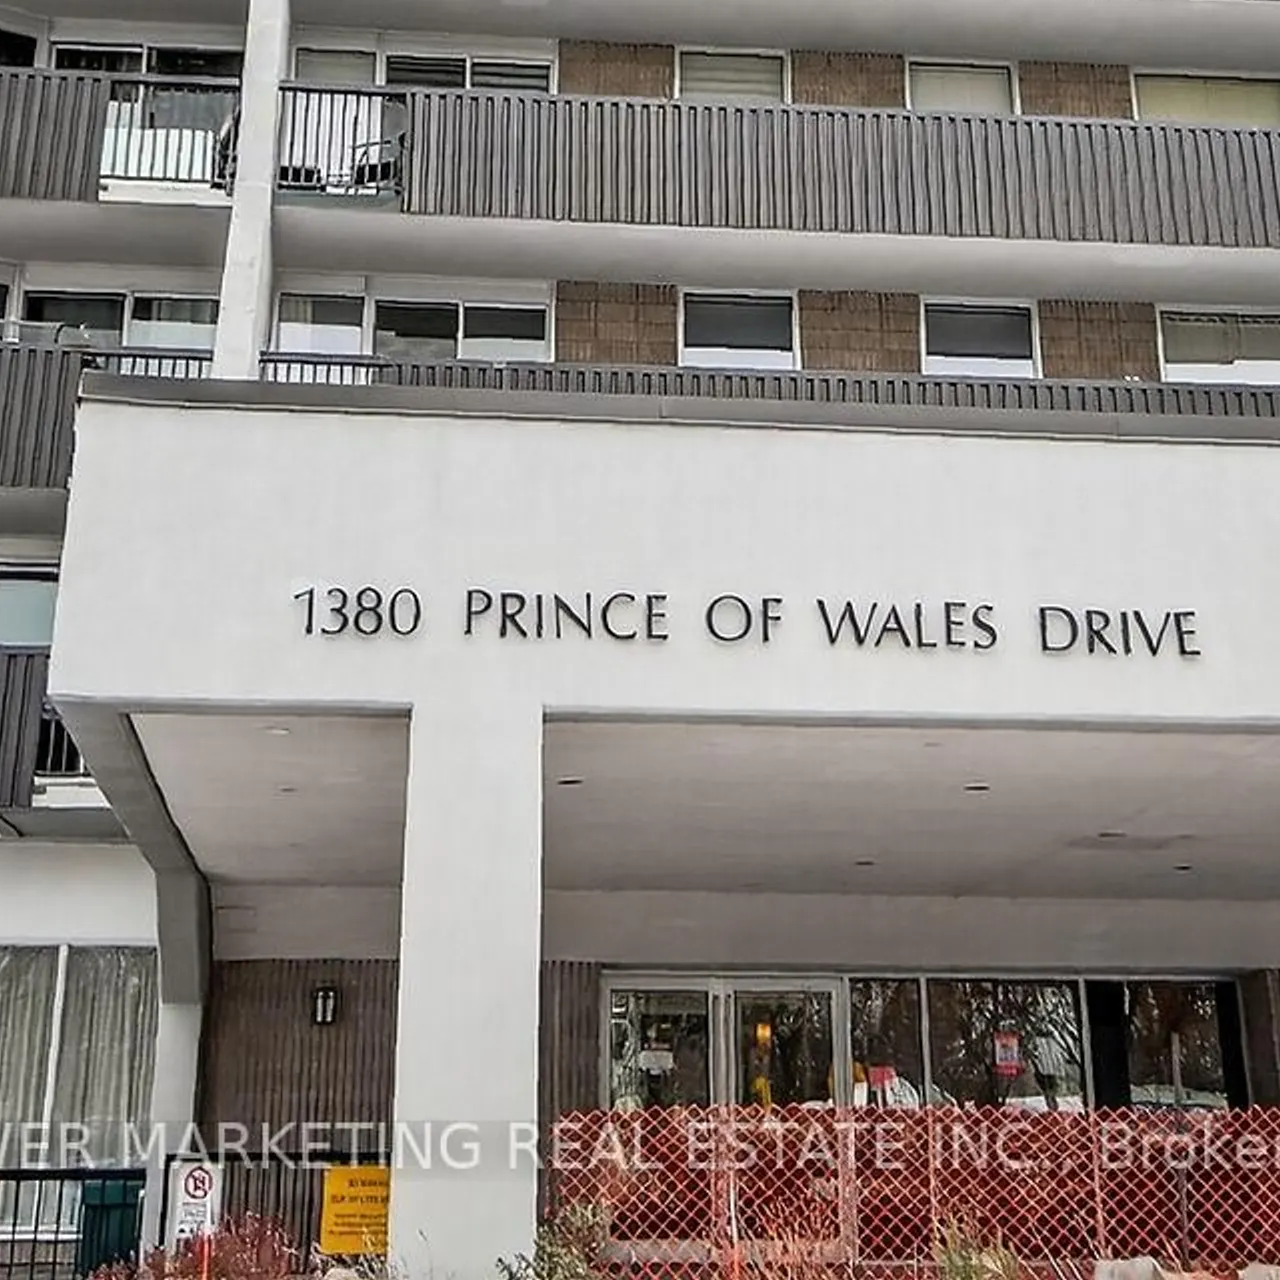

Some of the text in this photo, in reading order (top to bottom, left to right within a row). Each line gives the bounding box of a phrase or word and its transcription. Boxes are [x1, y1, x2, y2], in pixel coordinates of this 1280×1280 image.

[292, 586, 1202, 657] 1380 PRINCE OF WALES DRIVE
